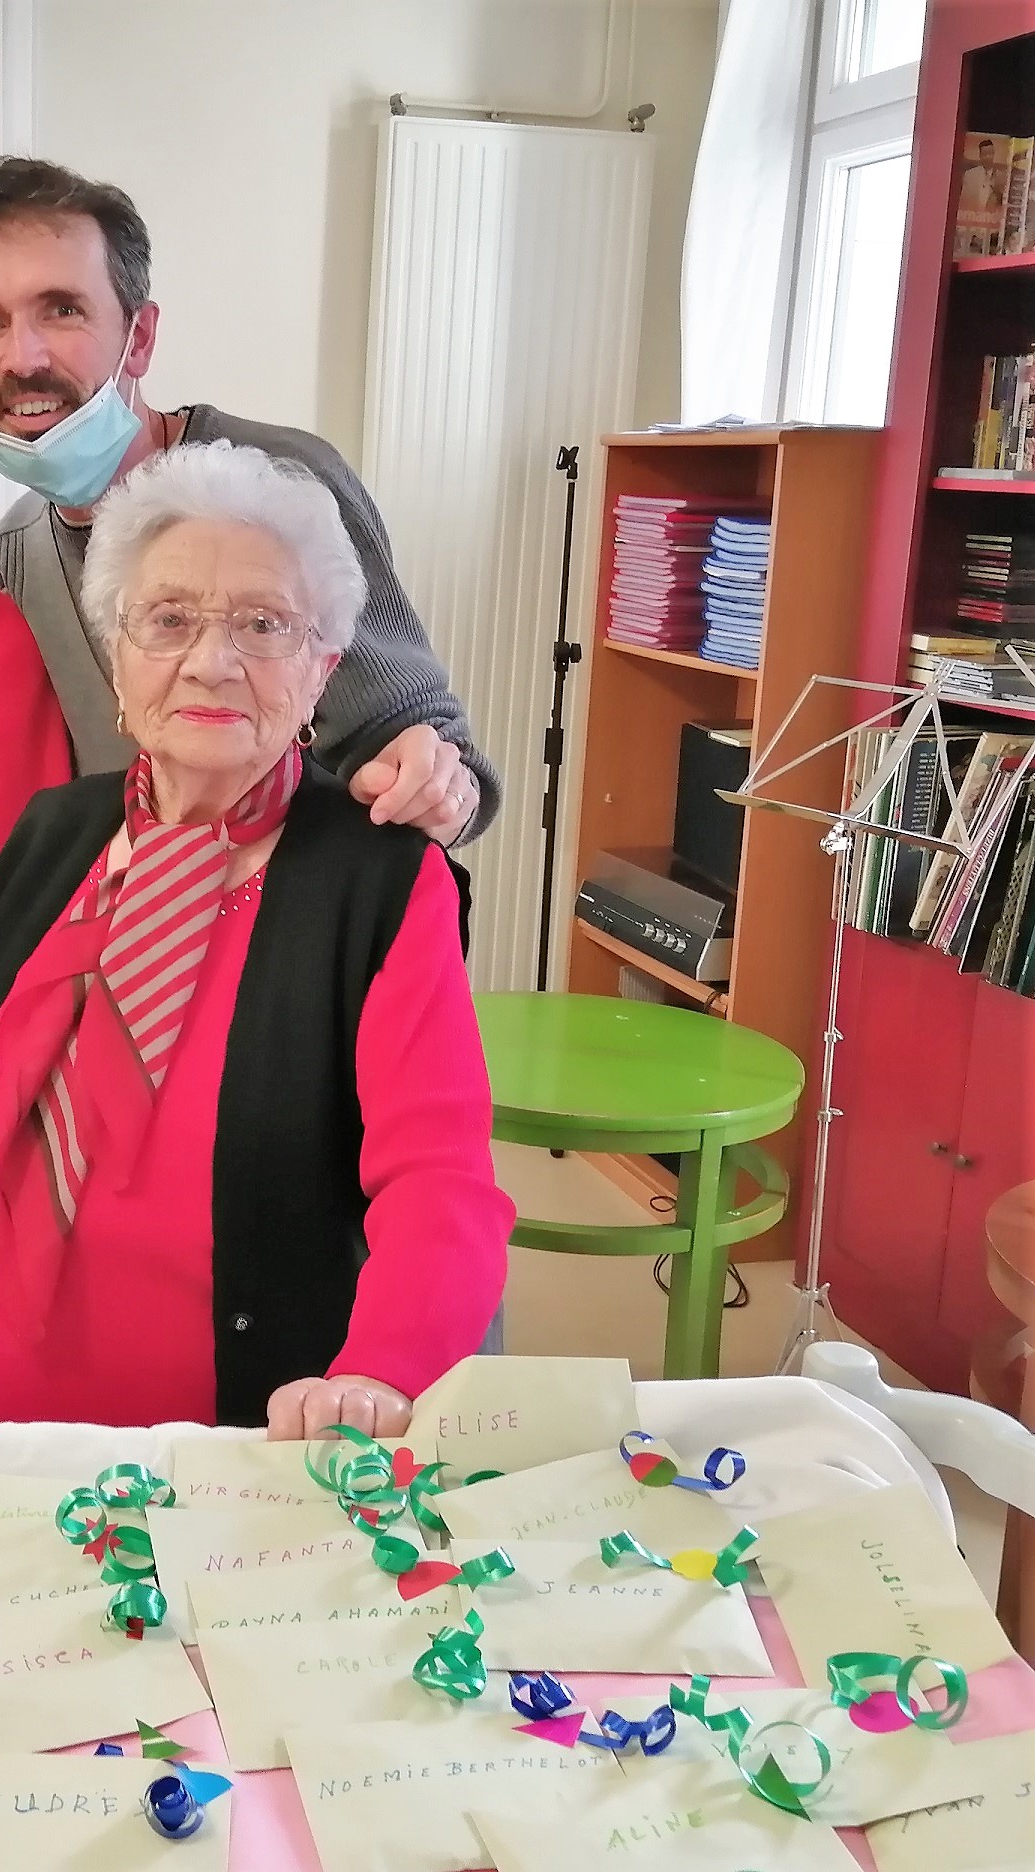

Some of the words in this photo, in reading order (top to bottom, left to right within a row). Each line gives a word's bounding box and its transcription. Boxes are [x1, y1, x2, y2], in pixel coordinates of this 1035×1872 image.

[204, 1538, 354, 1572] NAFANTA
[536, 1581, 663, 1597] JEANNE
[446, 1755, 603, 1777] BERTHELOT
